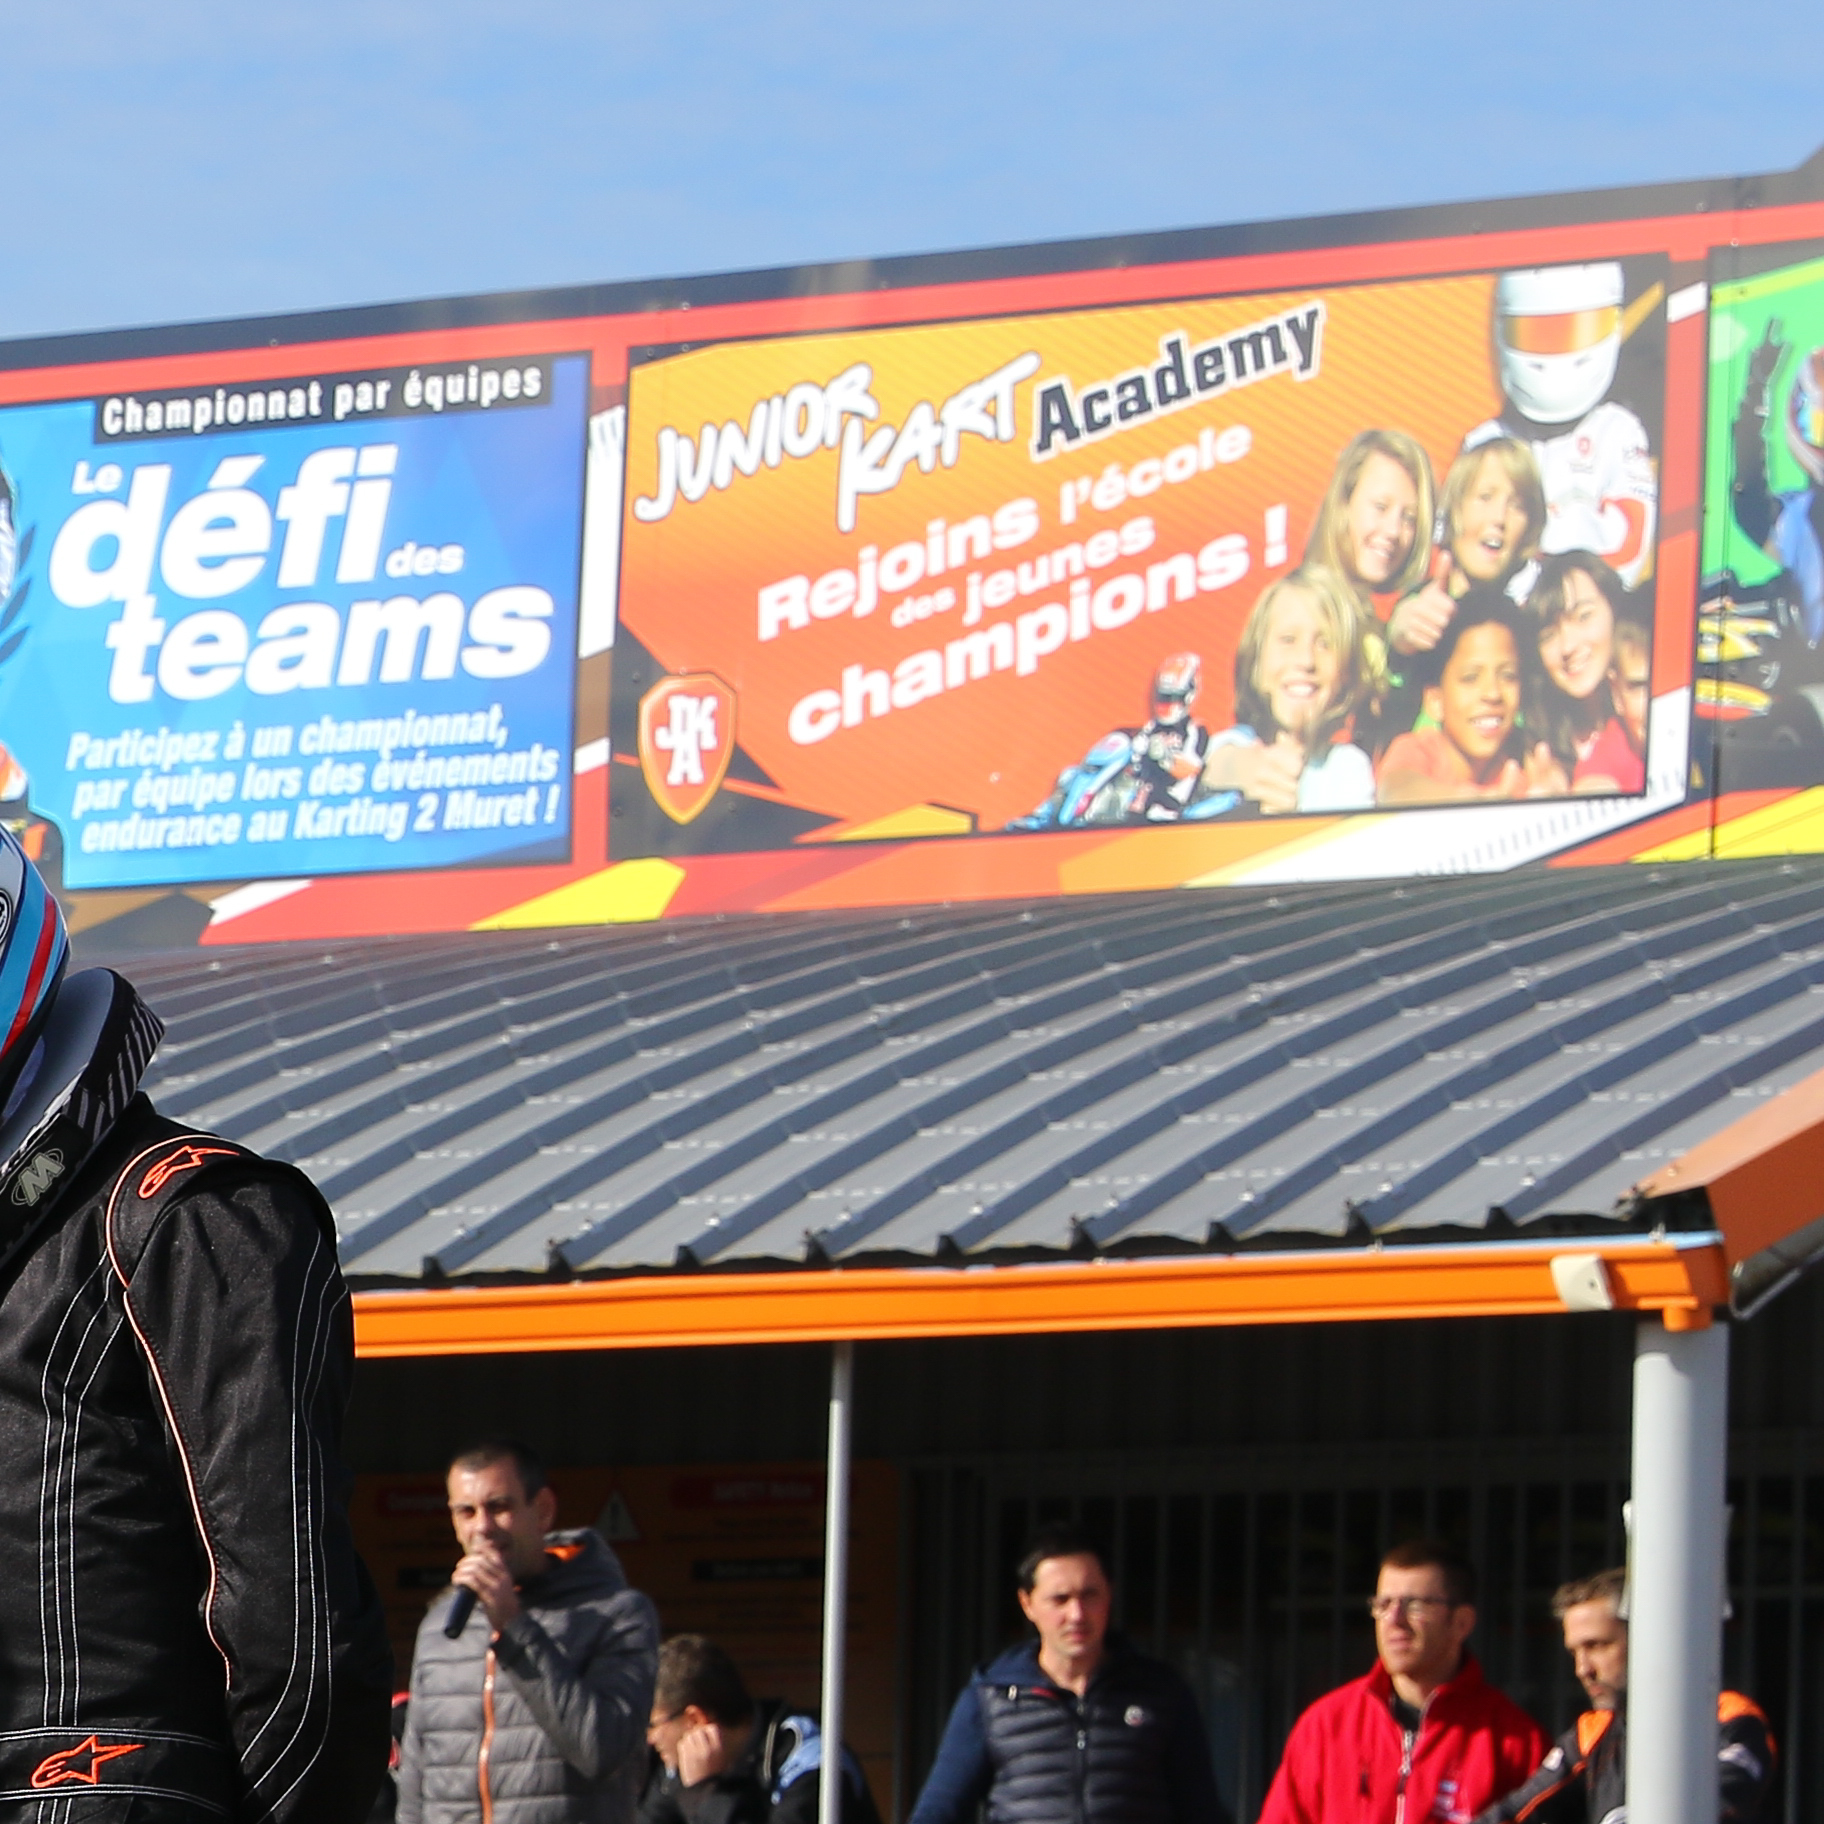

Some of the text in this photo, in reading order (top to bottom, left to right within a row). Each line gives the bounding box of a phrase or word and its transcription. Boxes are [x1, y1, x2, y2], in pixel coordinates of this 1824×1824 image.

[103, 363, 544, 436] Championnat par équipes
[634, 362, 879, 522] JUNIOR
[837, 302, 1326, 533] KART Academy
[48, 444, 465, 610] défi des
[72, 460, 123, 496] Le
[757, 423, 1255, 643] Rejoins l'école
[891, 515, 1157, 629] des jeunes
[107, 586, 555, 706] teams
[788, 535, 1253, 746] champions
[66, 704, 509, 773] Participez à un championnat,
[73, 744, 560, 819] par équipe lors des événements
[81, 811, 241, 854] endurance
[247, 809, 284, 842] au
[293, 798, 408, 843] Karting
[414, 793, 438, 832] 2
[444, 786, 539, 830] Muret
